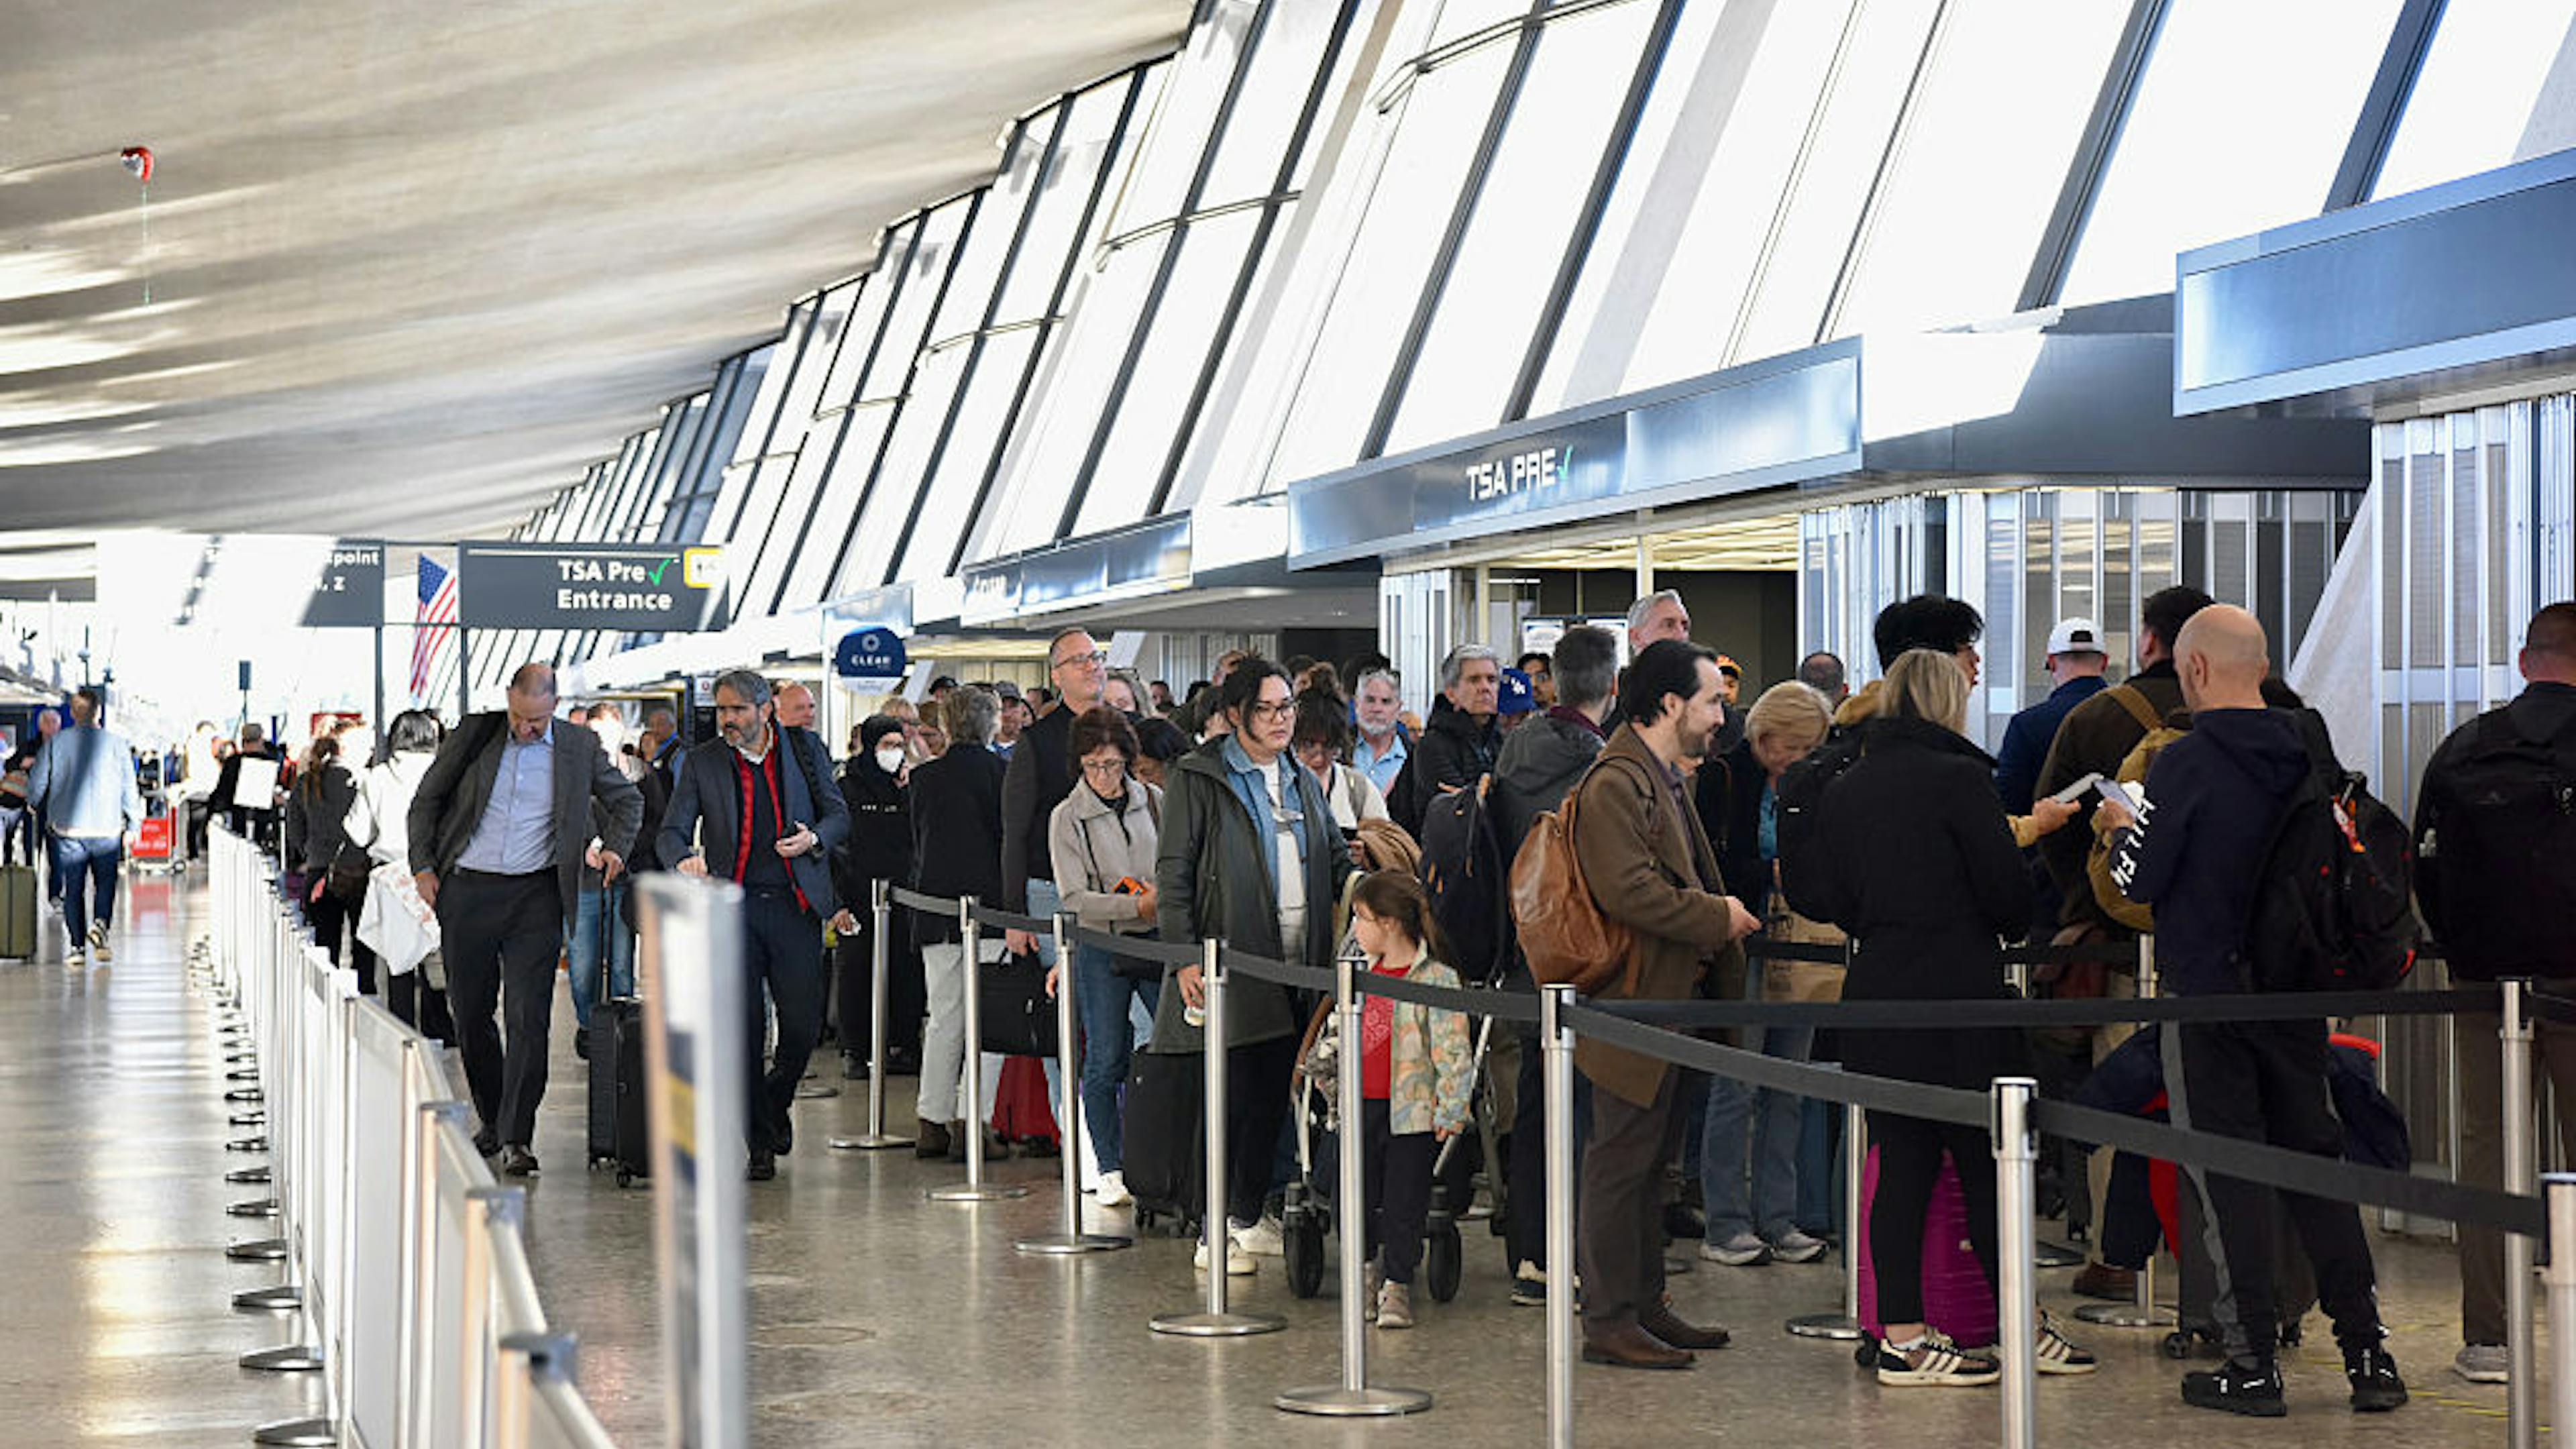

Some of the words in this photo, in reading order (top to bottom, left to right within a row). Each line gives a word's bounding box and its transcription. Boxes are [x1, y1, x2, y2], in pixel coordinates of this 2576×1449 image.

[1466, 460, 1508, 501] TSA
[1511, 447, 1556, 493] PRE
[557, 558, 604, 582] TSA
[607, 561, 646, 583] Pre
[557, 588, 673, 610] Entrance
[851, 654, 892, 667] CLEAR
